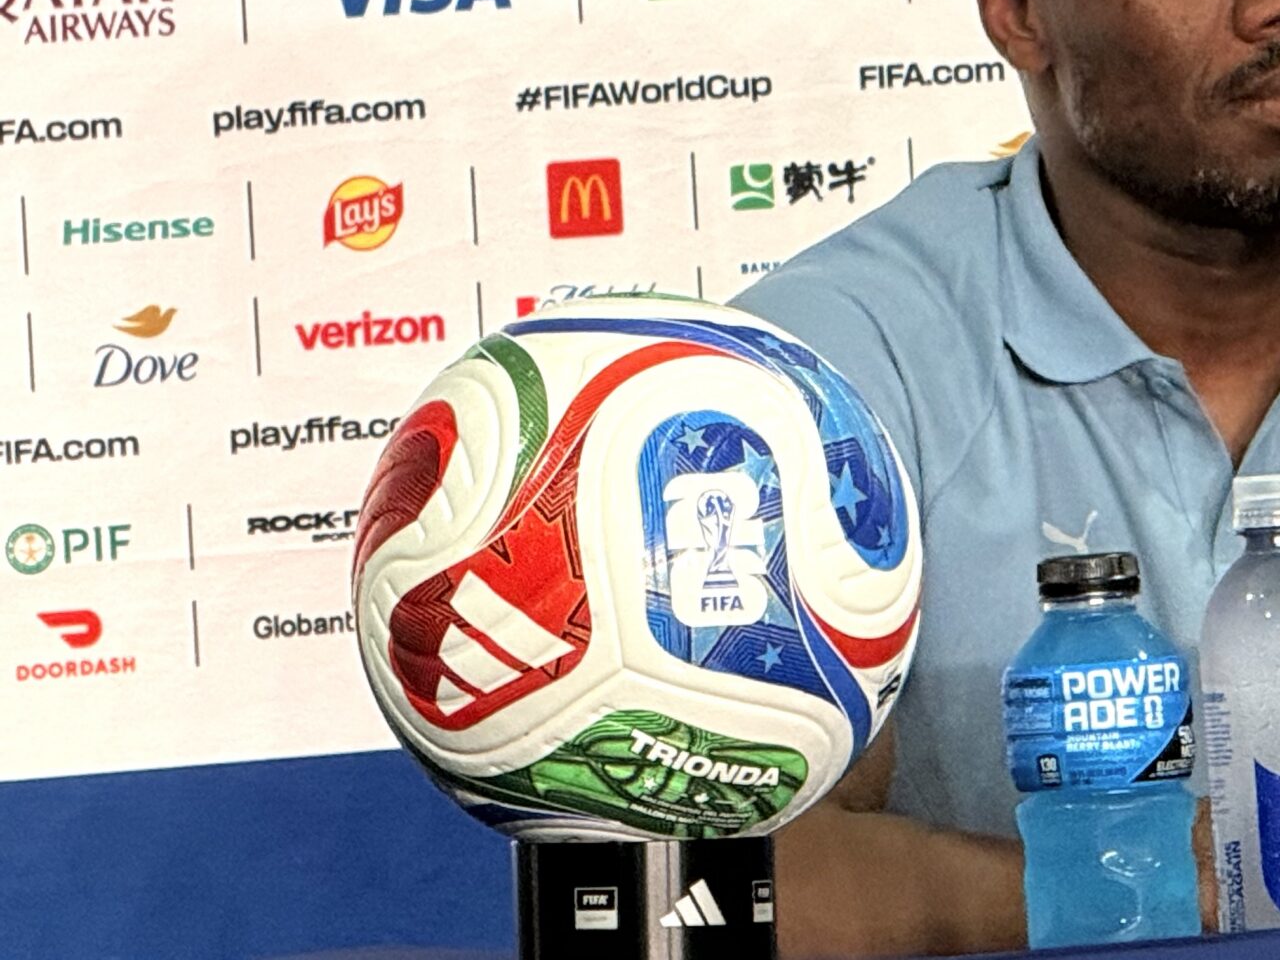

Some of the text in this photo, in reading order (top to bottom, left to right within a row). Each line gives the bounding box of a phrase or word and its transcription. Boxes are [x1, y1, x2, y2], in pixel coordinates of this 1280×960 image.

[24, 7, 176, 45] AIRWAYS
[213, 99, 425, 137] play.fifa.com
[516, 75, 772, 111] #FIFAWorldCup
[859, 61, 1005, 90] FIFA.com
[64, 217, 214, 245] Hisense
[334, 191, 396, 237] Lay's
[295, 311, 445, 350] verizon
[94, 344, 198, 387] Dove
[230, 416, 400, 454] play.fifa.c
[62, 525, 131, 563] PIF
[701, 596, 744, 613] FIFA
[253, 613, 356, 640] Globant
[16, 657, 136, 681] DOORDASH
[1062, 662, 1180, 701] POWER
[1064, 697, 1138, 732] ADE
[630, 728, 780, 787] TRIONDA
[582, 893, 609, 906] FIFA
